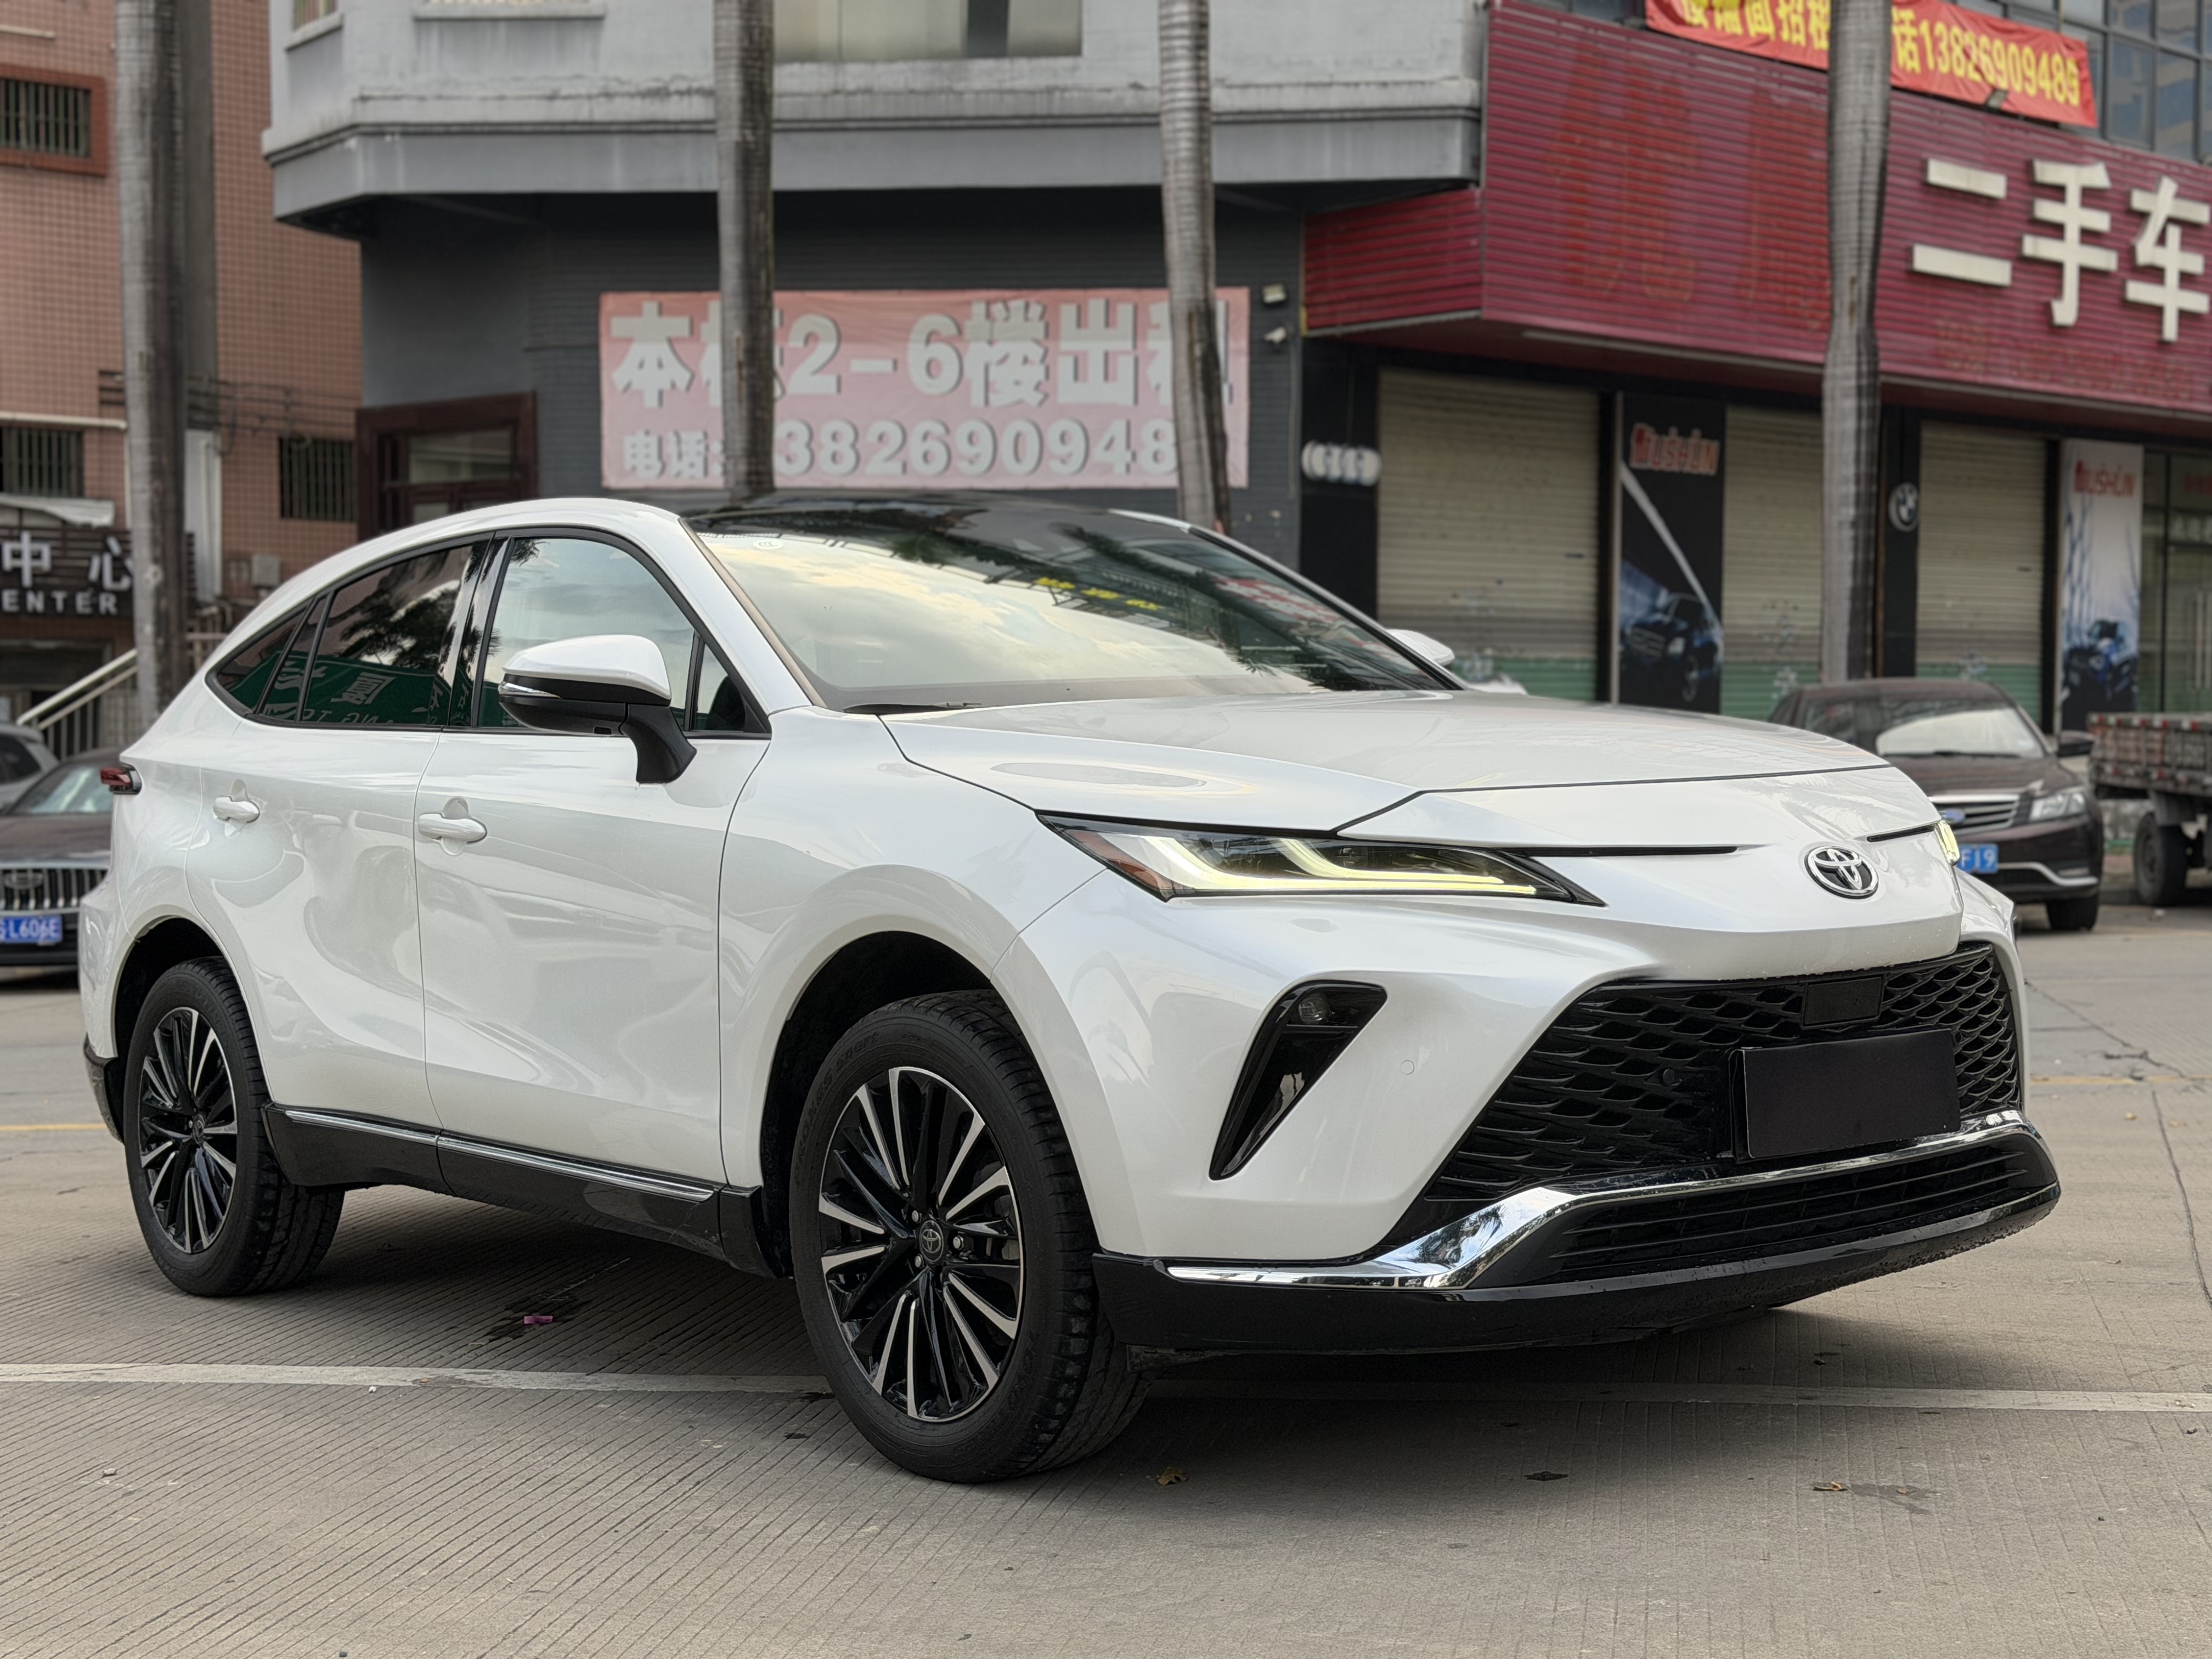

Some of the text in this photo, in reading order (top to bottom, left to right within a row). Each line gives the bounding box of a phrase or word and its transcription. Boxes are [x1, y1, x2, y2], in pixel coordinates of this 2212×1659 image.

[1912, 157, 2211, 342] 二手车
[2, 531, 133, 590] 中心
